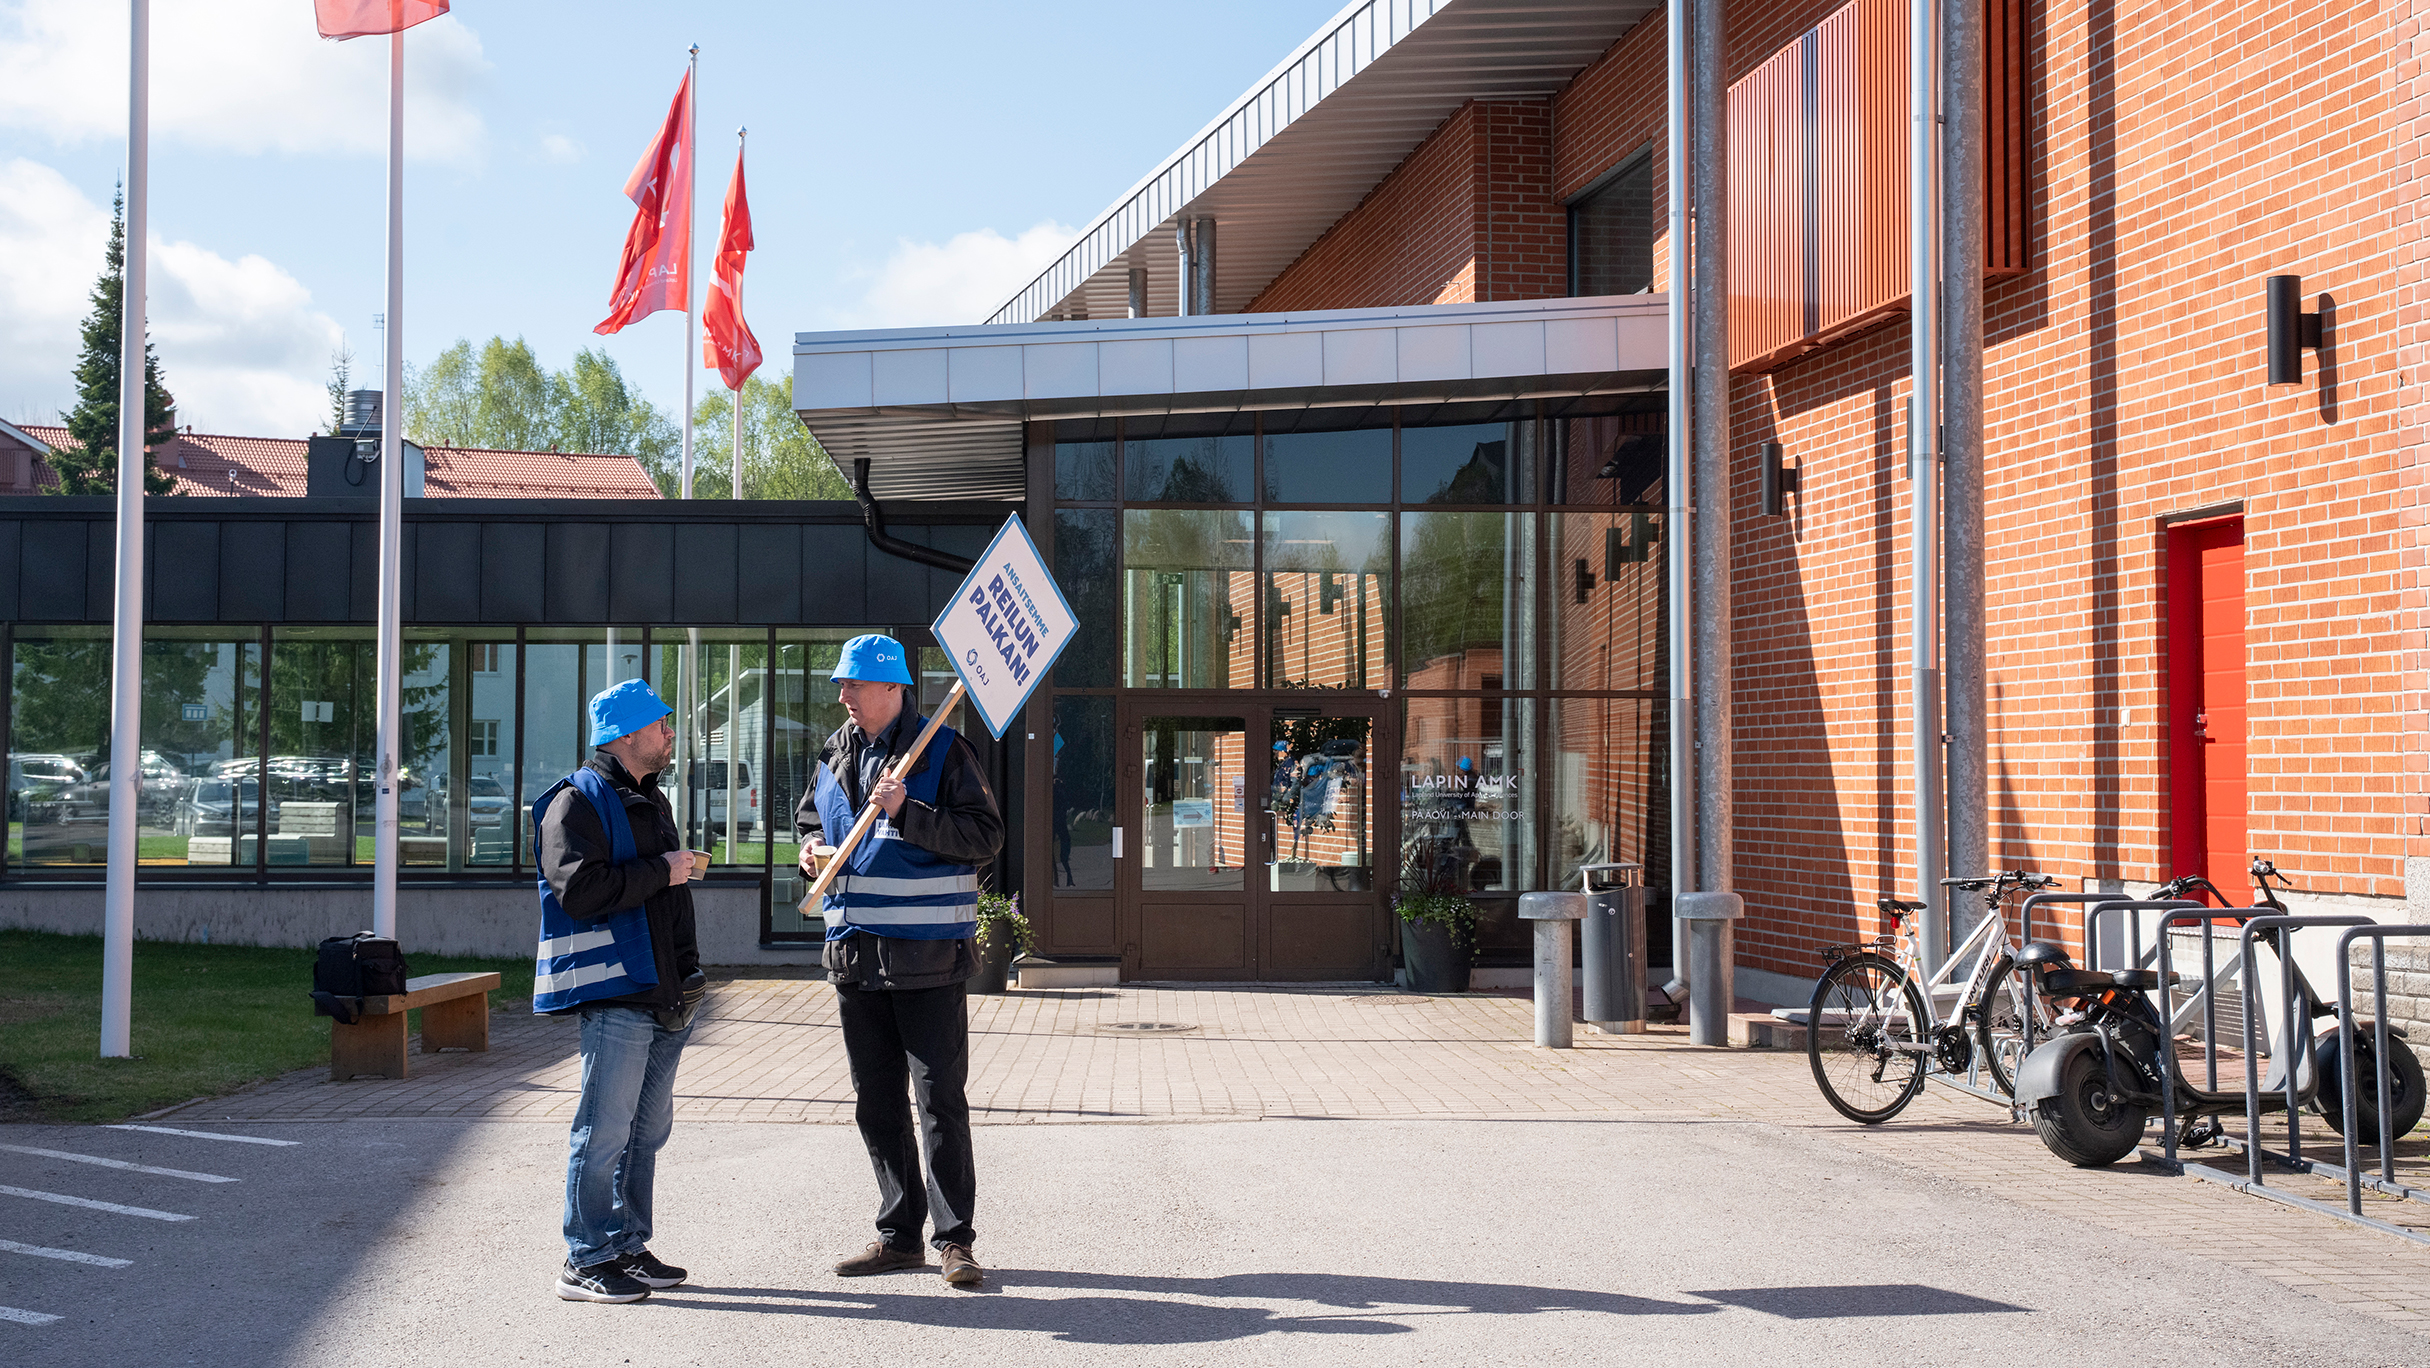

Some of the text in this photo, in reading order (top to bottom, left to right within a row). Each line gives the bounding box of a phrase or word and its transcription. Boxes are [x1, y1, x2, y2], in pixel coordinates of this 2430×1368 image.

[988, 573, 1040, 658] REILUN
[1003, 562, 1049, 638] ANSAITSEMME
[969, 585, 1031, 687] PALKAN!
[976, 665, 990, 686] OAJ
[1412, 775, 1518, 788] LAPIN AMK
[1461, 810, 1489, 819] MAIN
[1493, 810, 1525, 819] DOOR
[1966, 954, 1992, 1003] UNTURI
